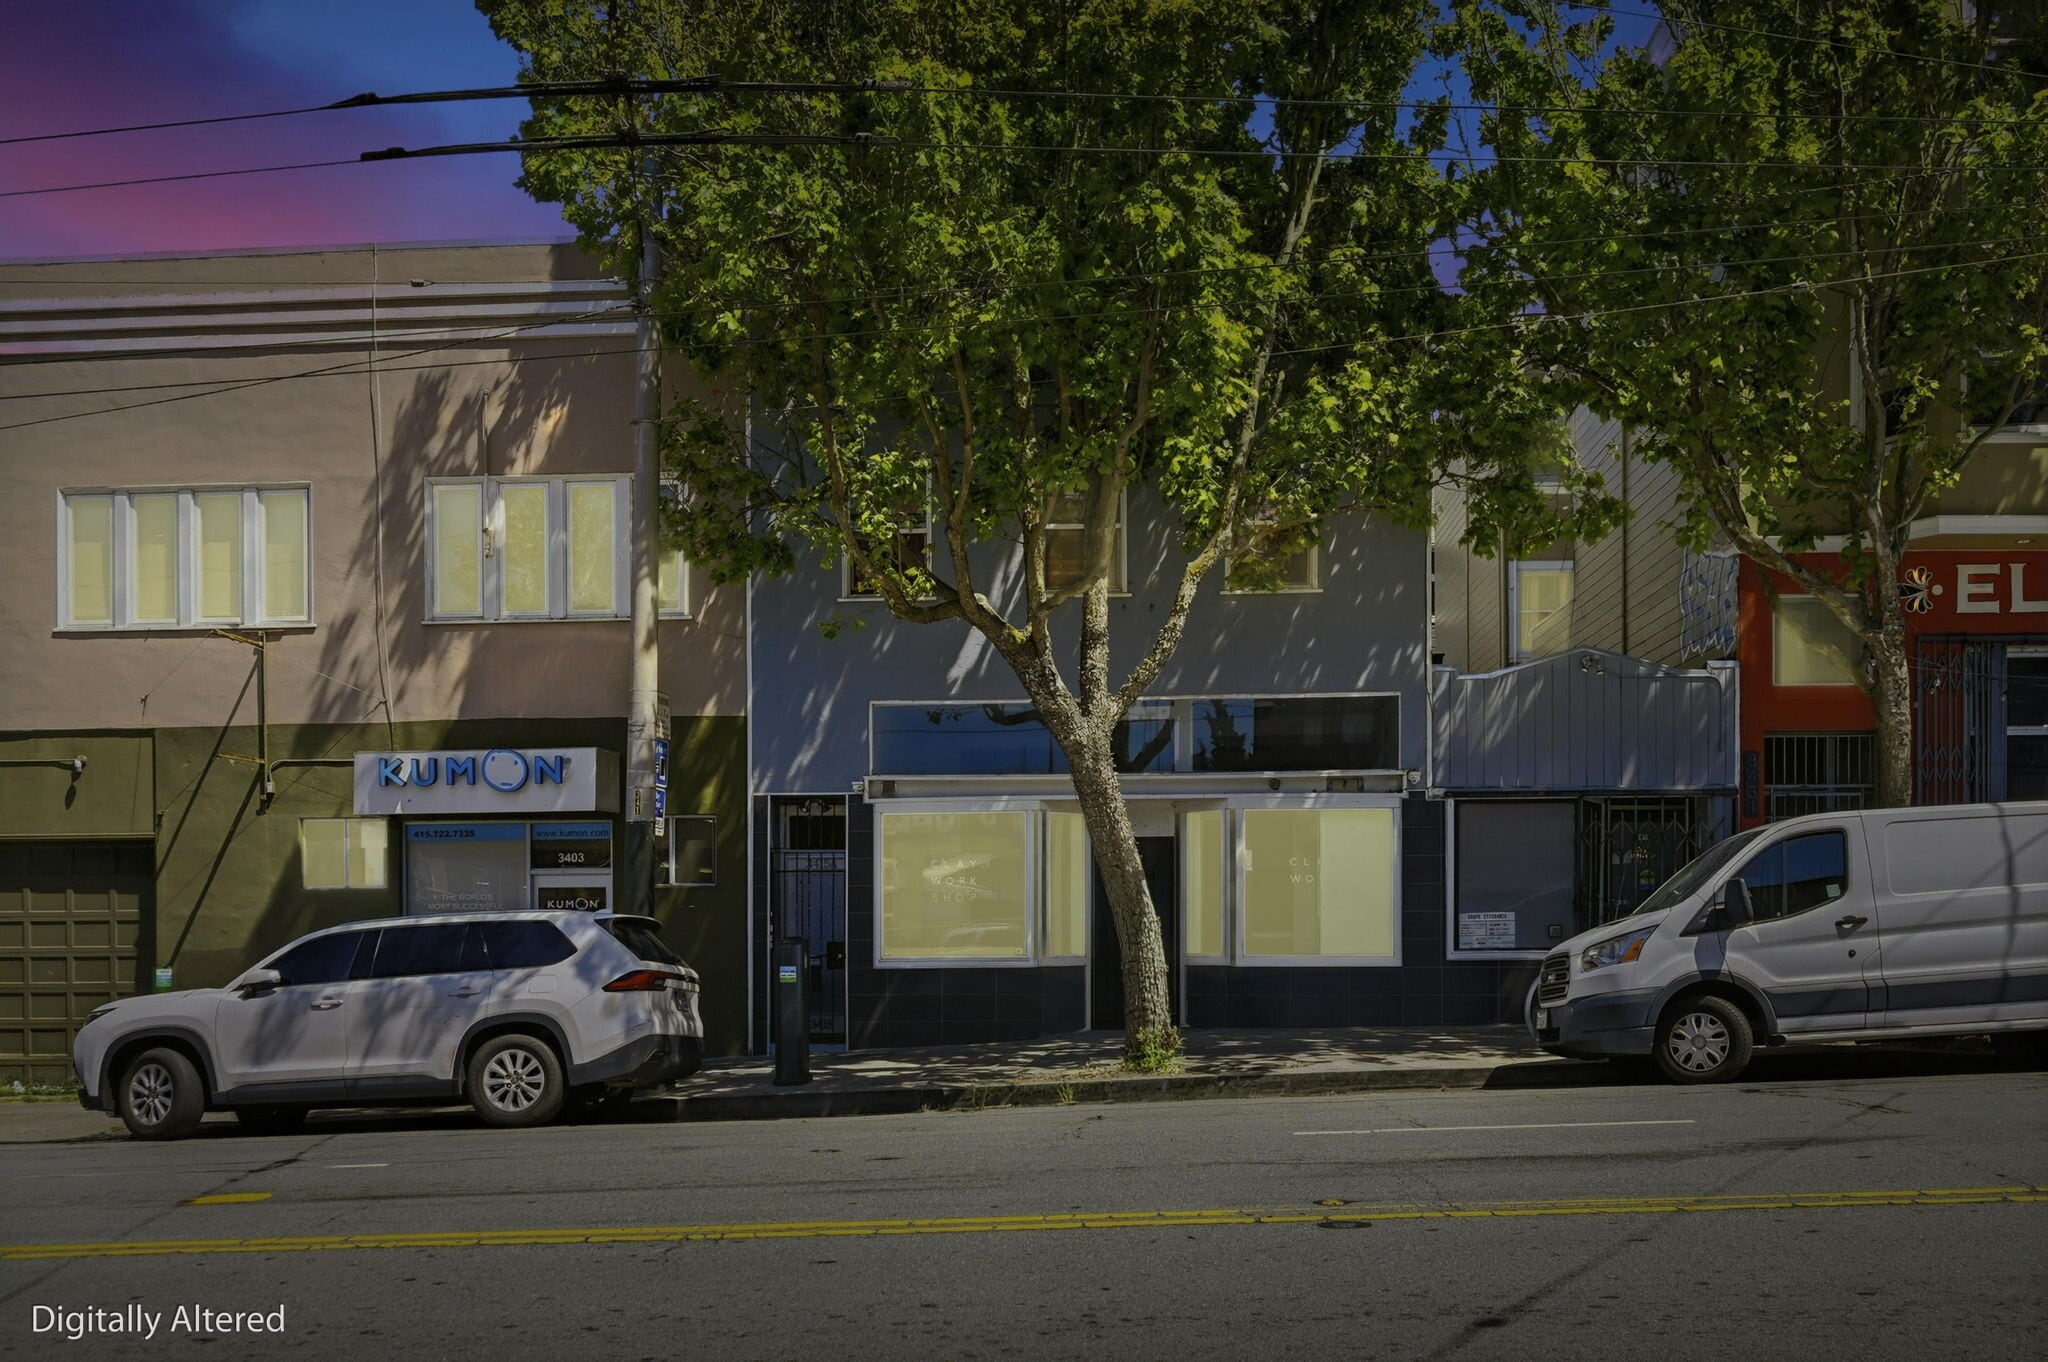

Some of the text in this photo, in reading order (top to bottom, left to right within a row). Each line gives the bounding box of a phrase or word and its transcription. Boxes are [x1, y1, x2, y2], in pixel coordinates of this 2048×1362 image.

[378, 748, 564, 793] KUMON
[413, 830, 475, 838] 415.722.7335
[535, 829, 609, 838] www.kumon.com
[557, 852, 585, 863] 3403
[930, 860, 977, 869] CLAY
[931, 877, 977, 886] WORK
[931, 893, 977, 902] SHOP
[547, 897, 598, 910] KUMON
